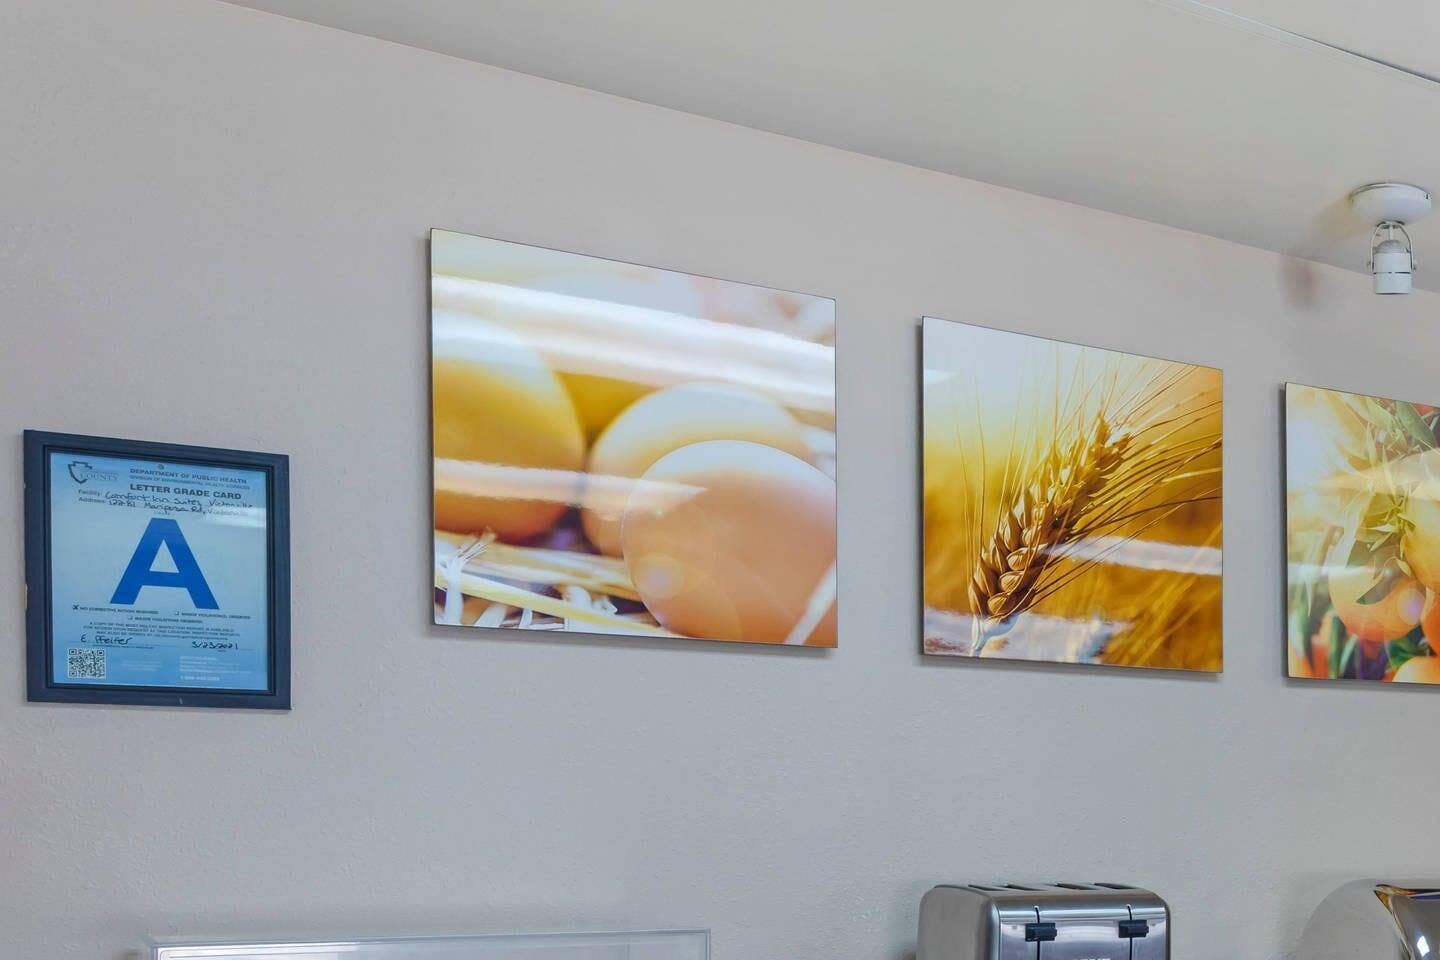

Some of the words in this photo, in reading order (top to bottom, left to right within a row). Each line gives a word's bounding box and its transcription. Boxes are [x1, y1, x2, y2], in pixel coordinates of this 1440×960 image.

[129, 468, 178, 477] DEPARTMENT
[191, 474, 218, 482] PUBLIC
[220, 477, 247, 485] HEALTH
[130, 483, 170, 494] LETTER
[173, 487, 210, 498] GRADE
[213, 491, 242, 500] CARD
[110, 517, 219, 609] A
